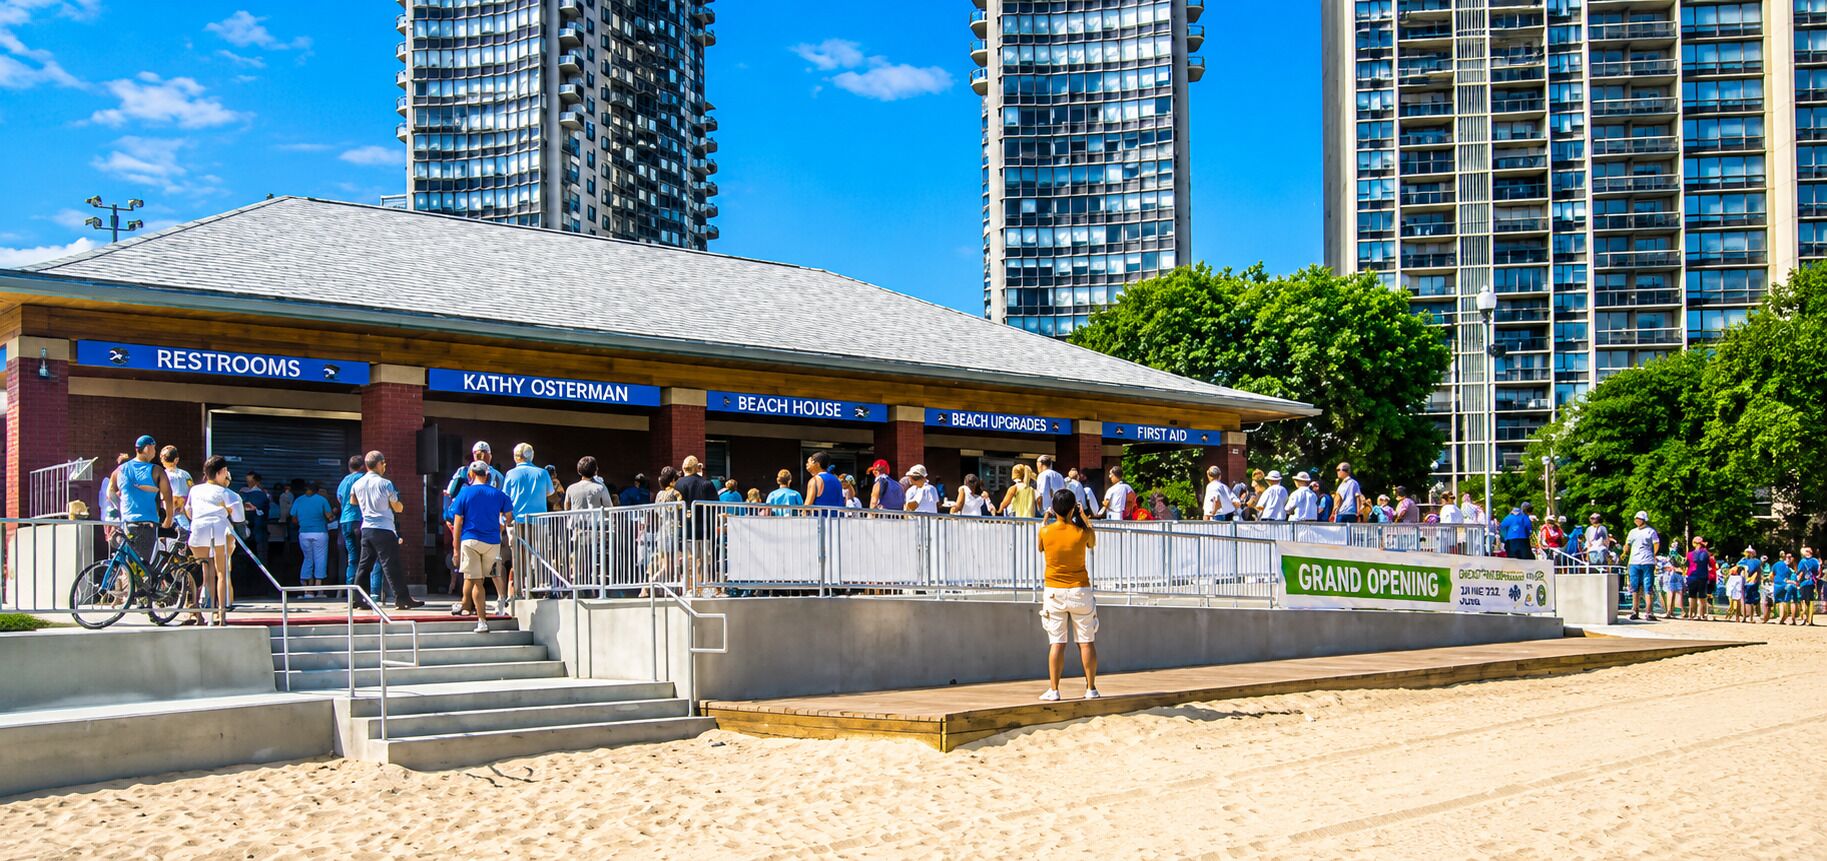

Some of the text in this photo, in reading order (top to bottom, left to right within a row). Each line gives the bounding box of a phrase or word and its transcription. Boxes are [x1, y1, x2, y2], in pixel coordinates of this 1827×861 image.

[157, 349, 301, 378] RESTROOMS
[463, 373, 628, 402] KATHY OSTERMAN
[738, 395, 842, 417] BEACH HOUSE
[952, 412, 1047, 432] BEACH UPGRADES
[1137, 426, 1187, 442] FIRST AID
[1298, 563, 1362, 593] GRAND
[1367, 568, 1439, 597] OPENING
